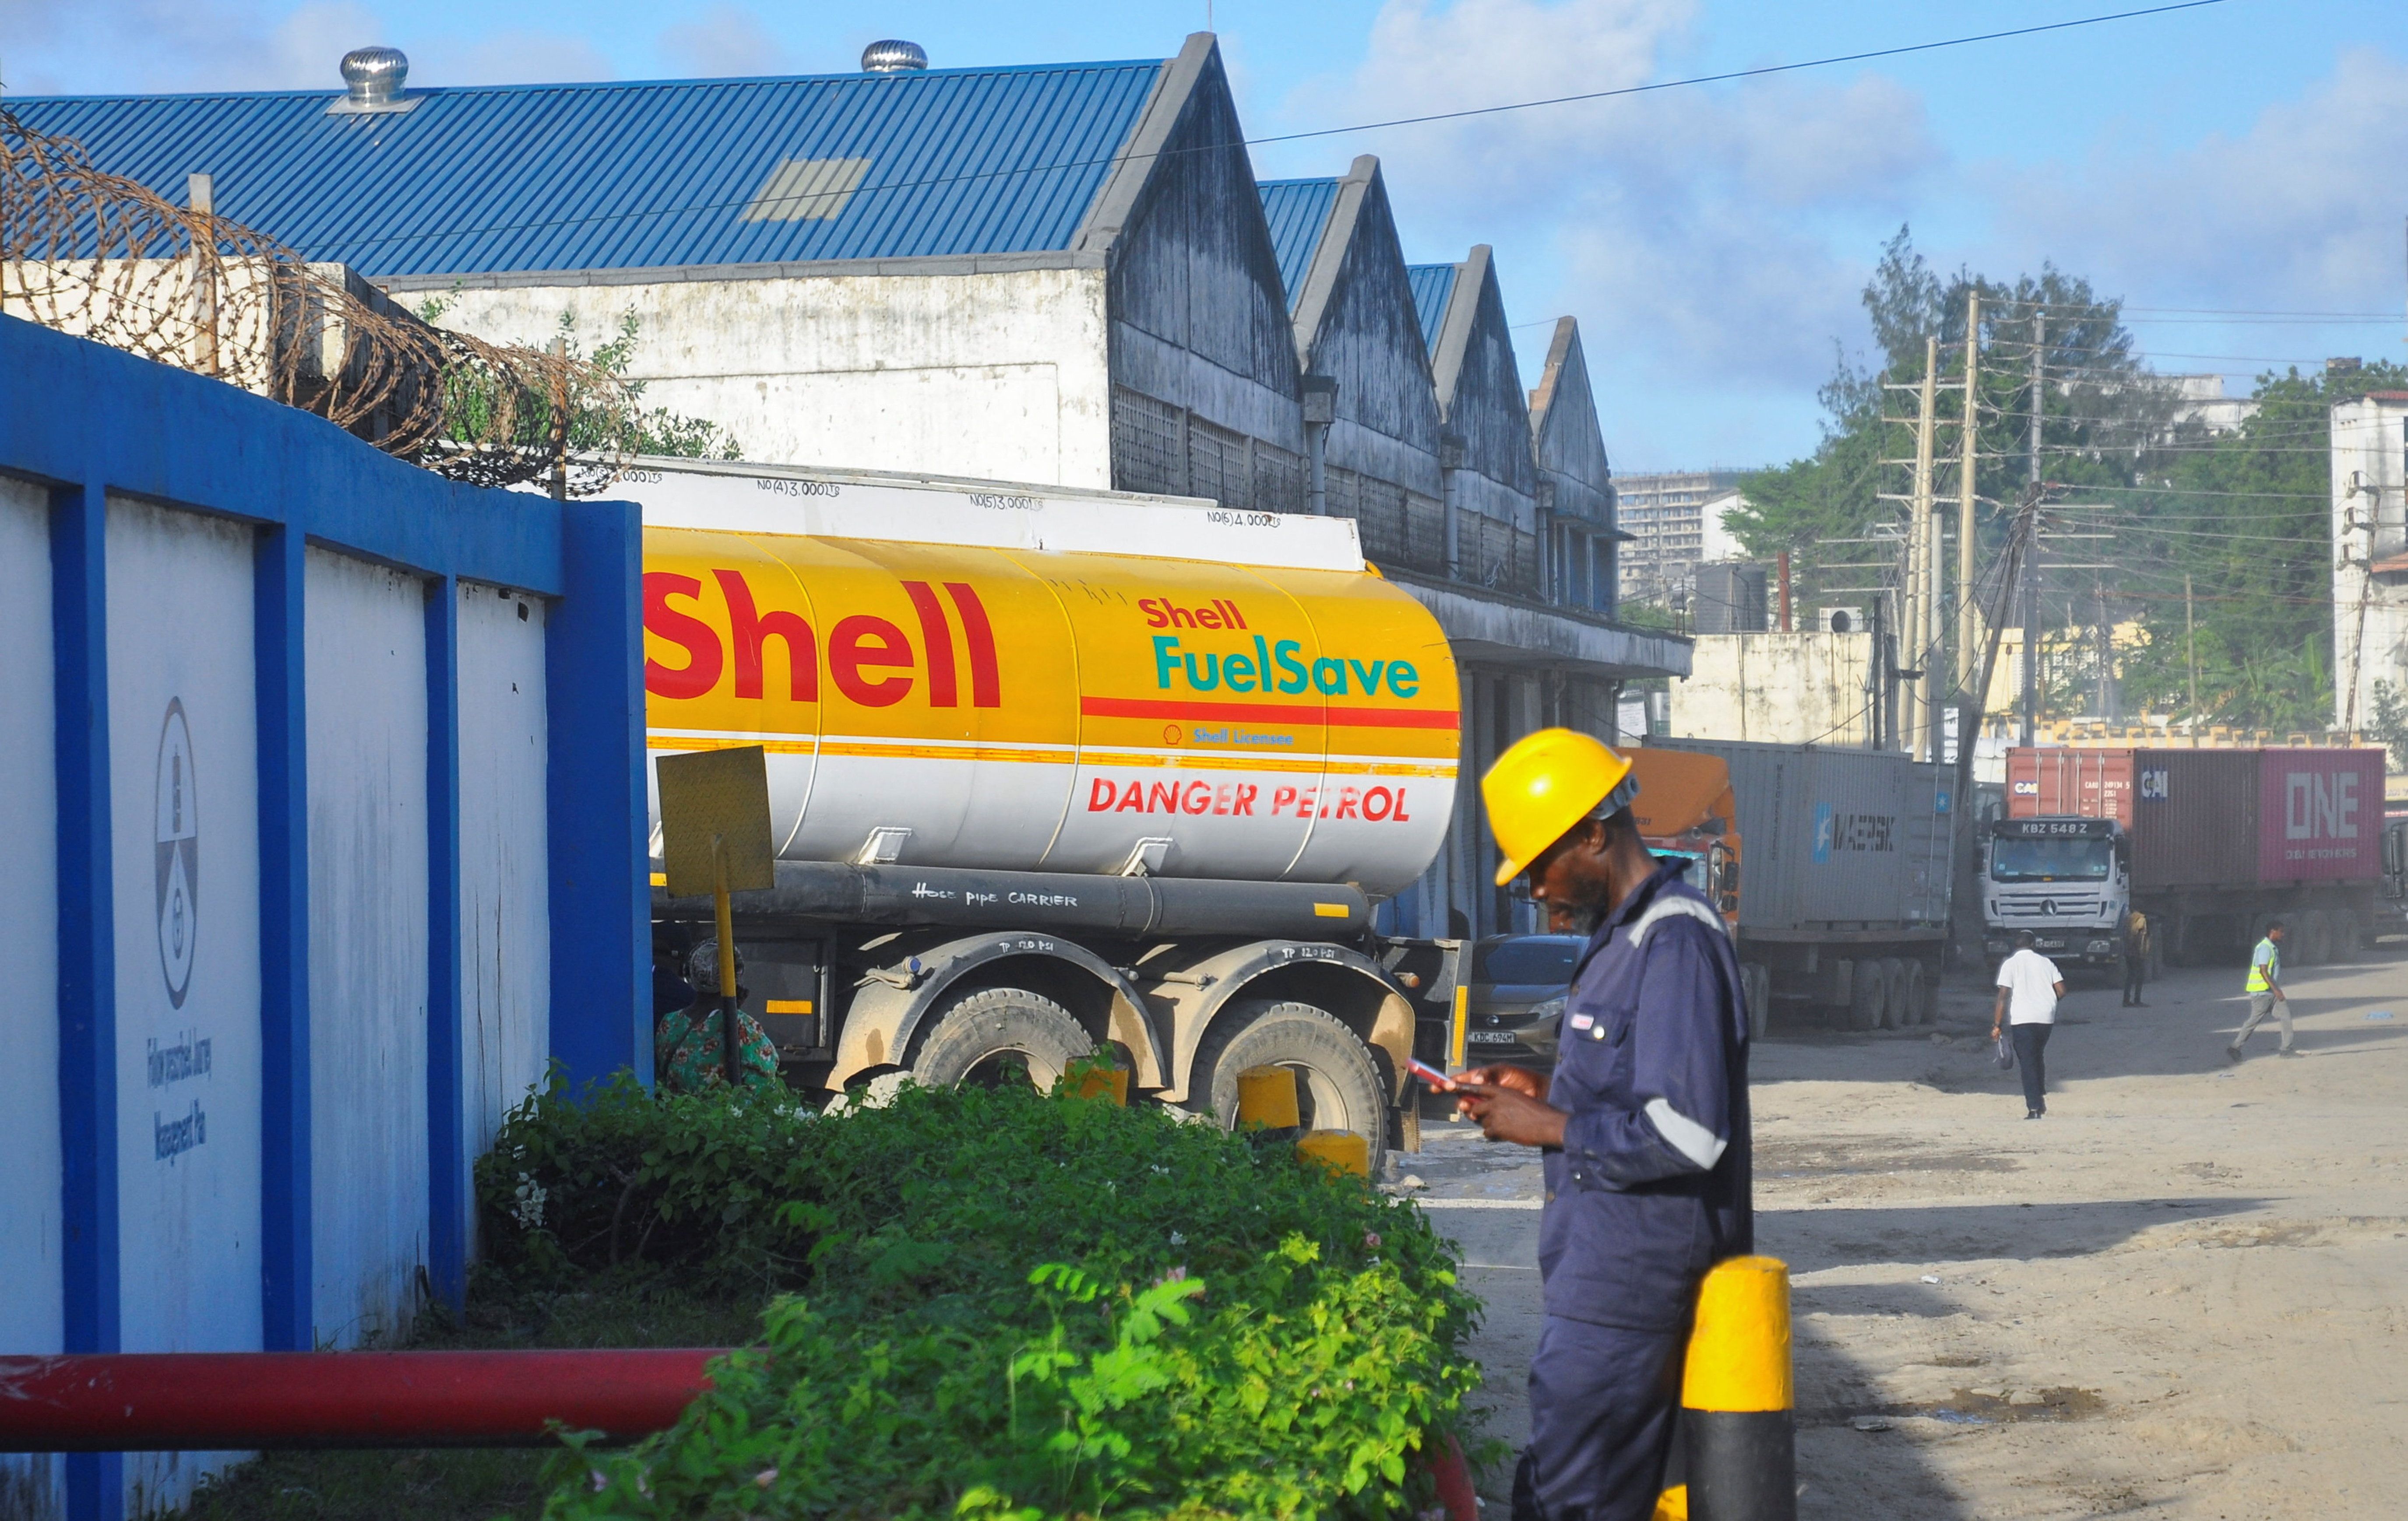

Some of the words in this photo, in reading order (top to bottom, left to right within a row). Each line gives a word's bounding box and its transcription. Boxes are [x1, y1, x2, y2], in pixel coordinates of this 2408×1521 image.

[1138, 598, 1247, 629] Shell
[642, 569, 1001, 708] Shell
[1152, 635, 1419, 699] FuelSave
[1193, 728, 1228, 744] Shell
[1233, 730, 1294, 745] Licensee
[1088, 777, 1257, 816] DANGER
[2286, 772, 2359, 840] ONE
[2022, 823, 2046, 833] KBZ
[1008, 892, 1078, 907] CARRIER
[1474, 1033, 1489, 1042] KDC
[1493, 1033, 1512, 1042] 694M
